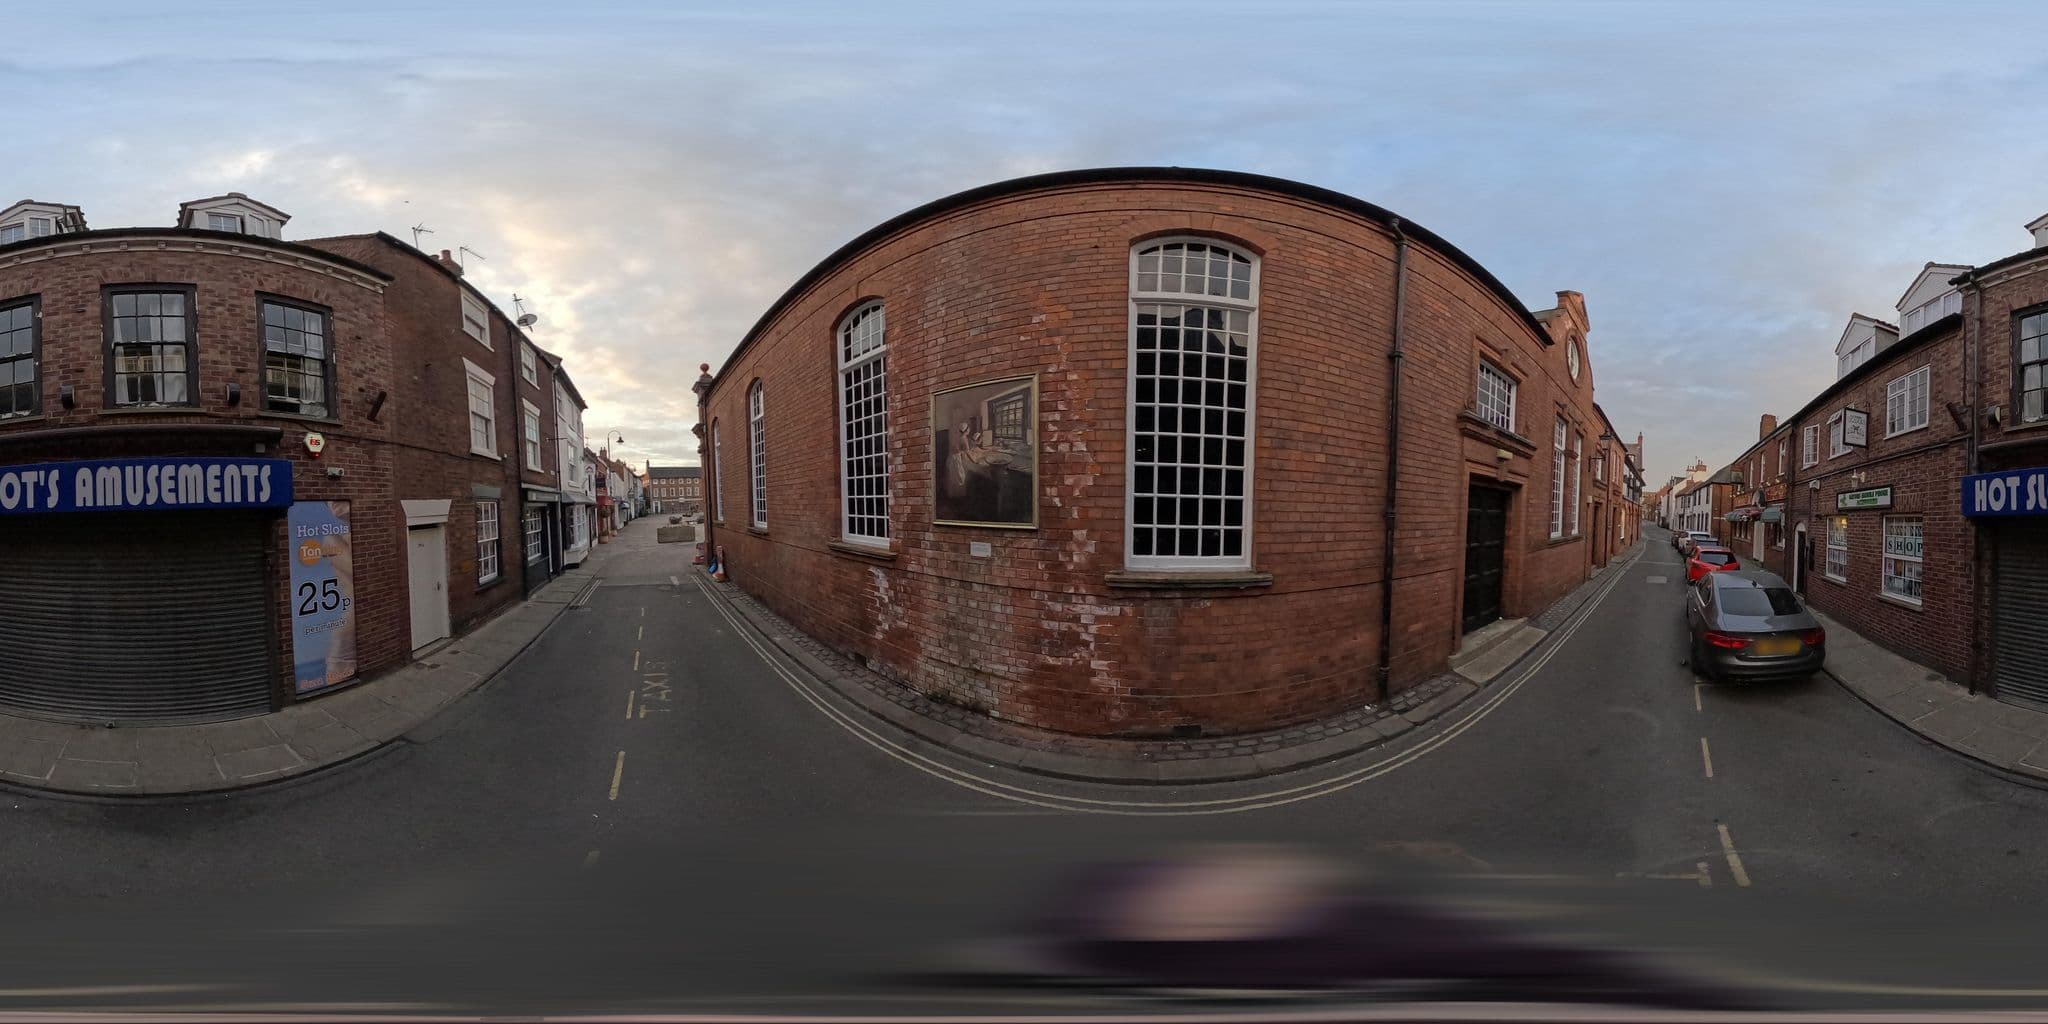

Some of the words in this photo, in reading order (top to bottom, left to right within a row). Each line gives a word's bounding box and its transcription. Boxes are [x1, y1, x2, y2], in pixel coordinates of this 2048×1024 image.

[0, 469, 60, 510] OT'S
[75, 464, 271, 507] AMUSEMENTS
[1975, 476, 2020, 512] HOT
[297, 525, 319, 538] Hot
[321, 523, 349, 535] Slots
[1887, 540, 1922, 553] SHOP
